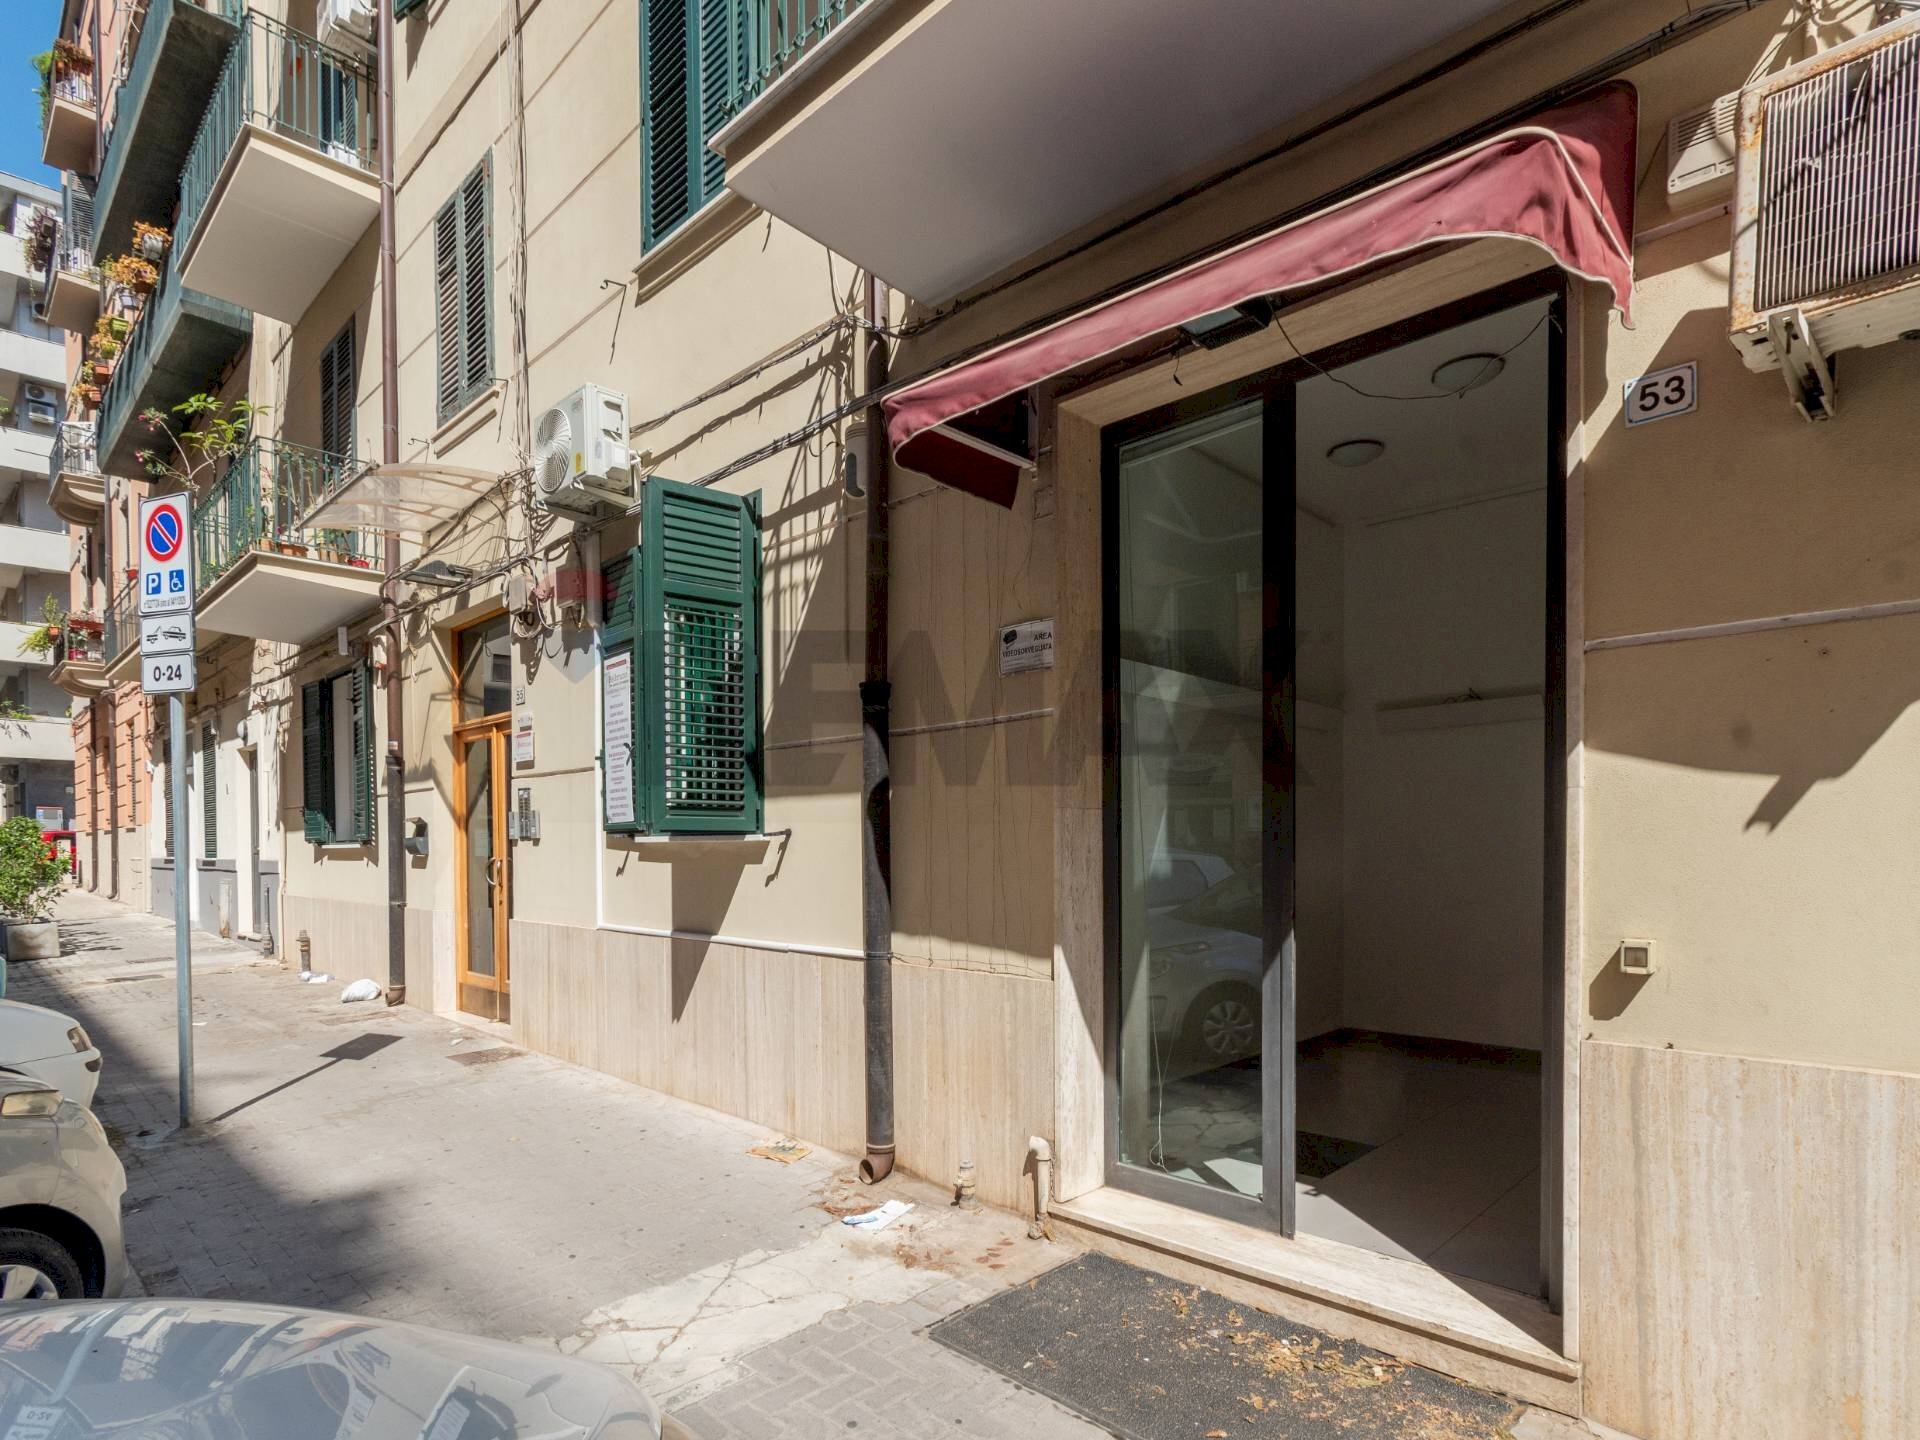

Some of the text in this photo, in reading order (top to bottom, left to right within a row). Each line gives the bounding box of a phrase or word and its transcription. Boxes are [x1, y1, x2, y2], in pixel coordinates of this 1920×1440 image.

[1639, 376, 1685, 411] 53
[148, 574, 159, 594] P
[1033, 632, 1052, 642] AREA
[154, 665, 182, 681] 0-24
